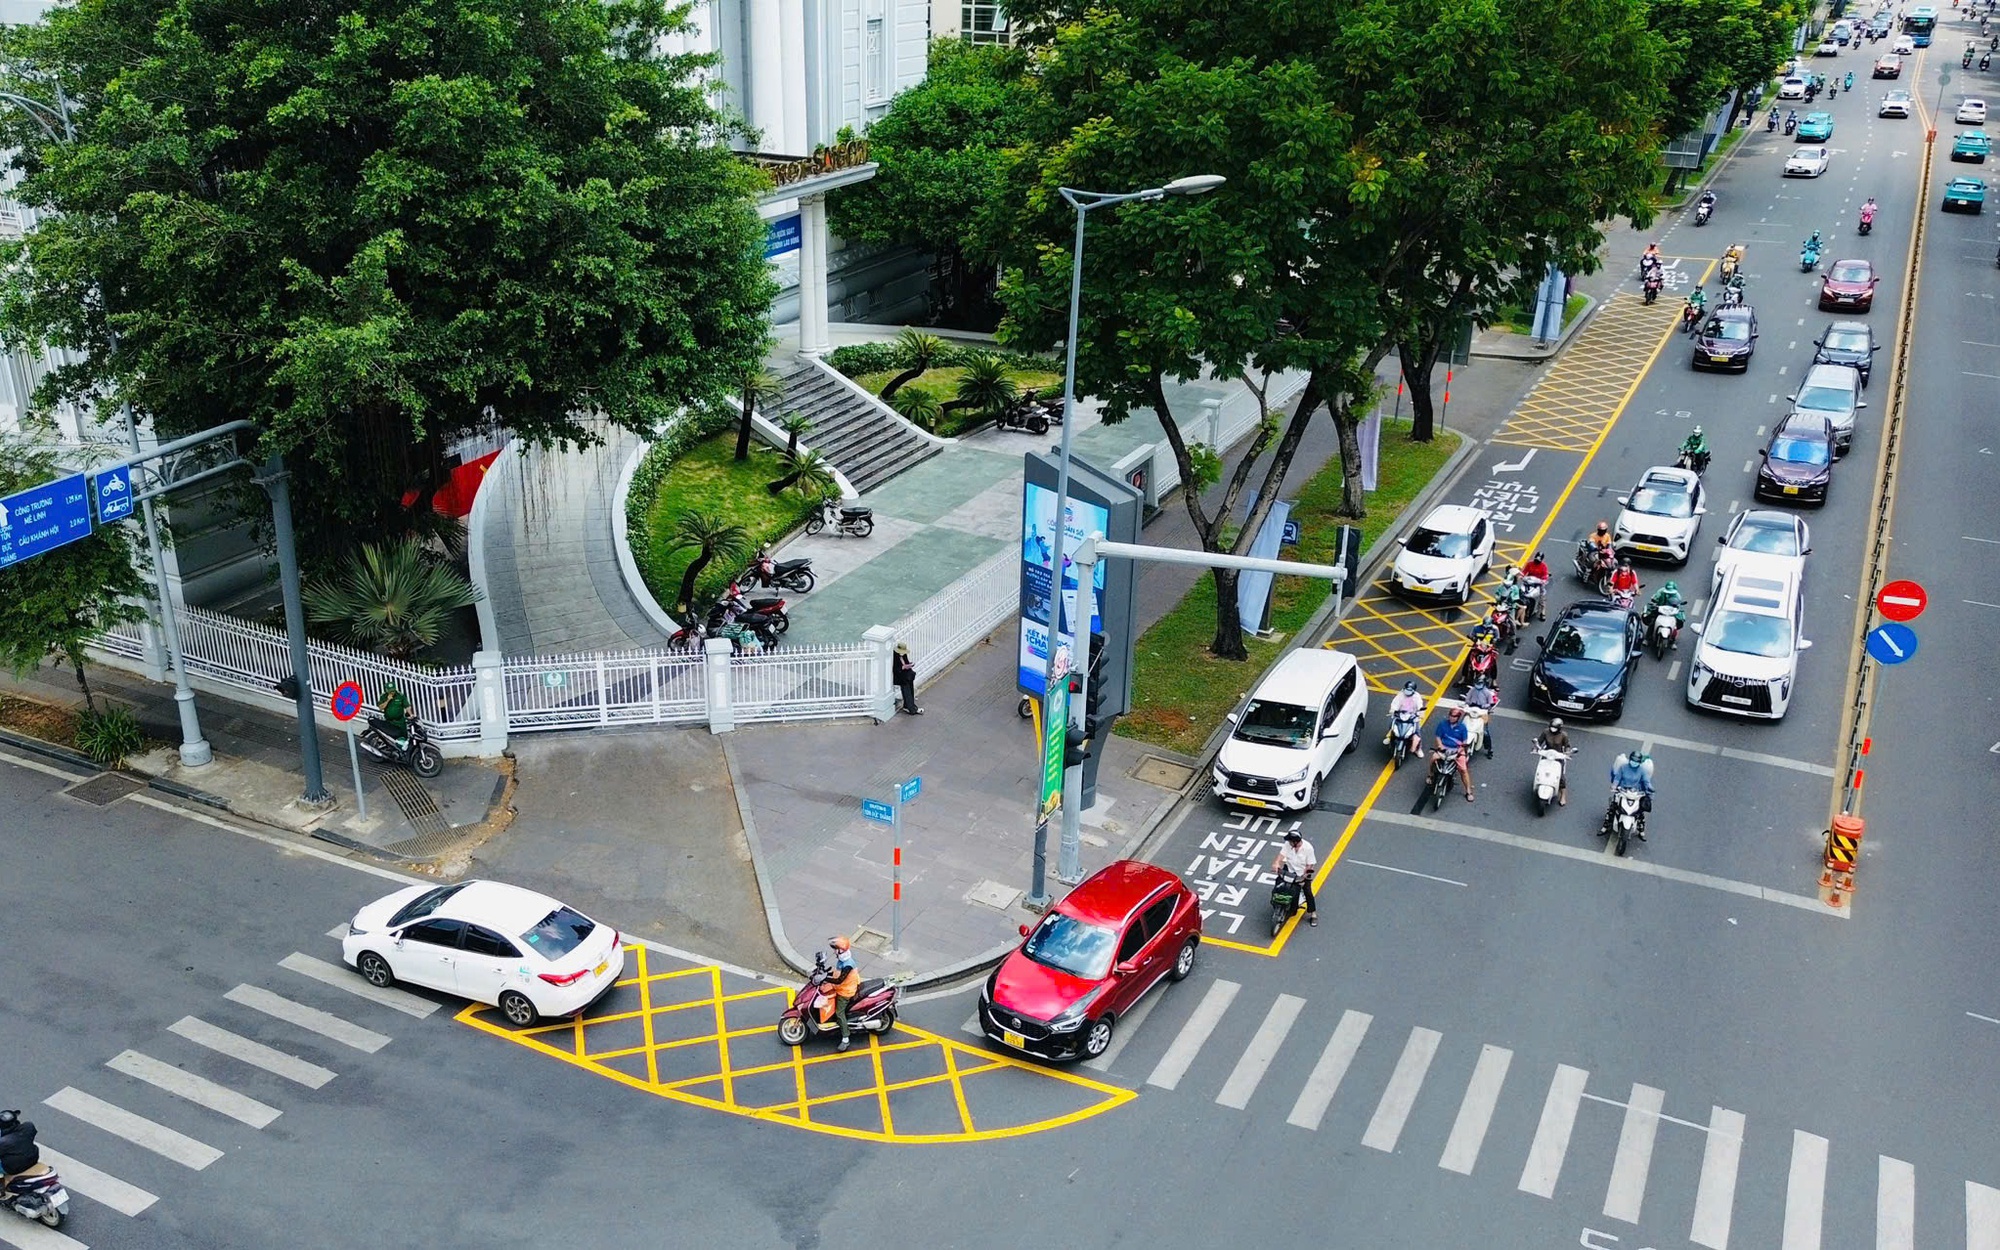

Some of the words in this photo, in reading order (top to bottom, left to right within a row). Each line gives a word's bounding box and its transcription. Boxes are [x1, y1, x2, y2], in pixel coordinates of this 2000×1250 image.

[1484, 480, 1538, 494] TỤC
[1473, 488, 1539, 504] LIÊN
[15, 504, 30, 517] CÔNG
